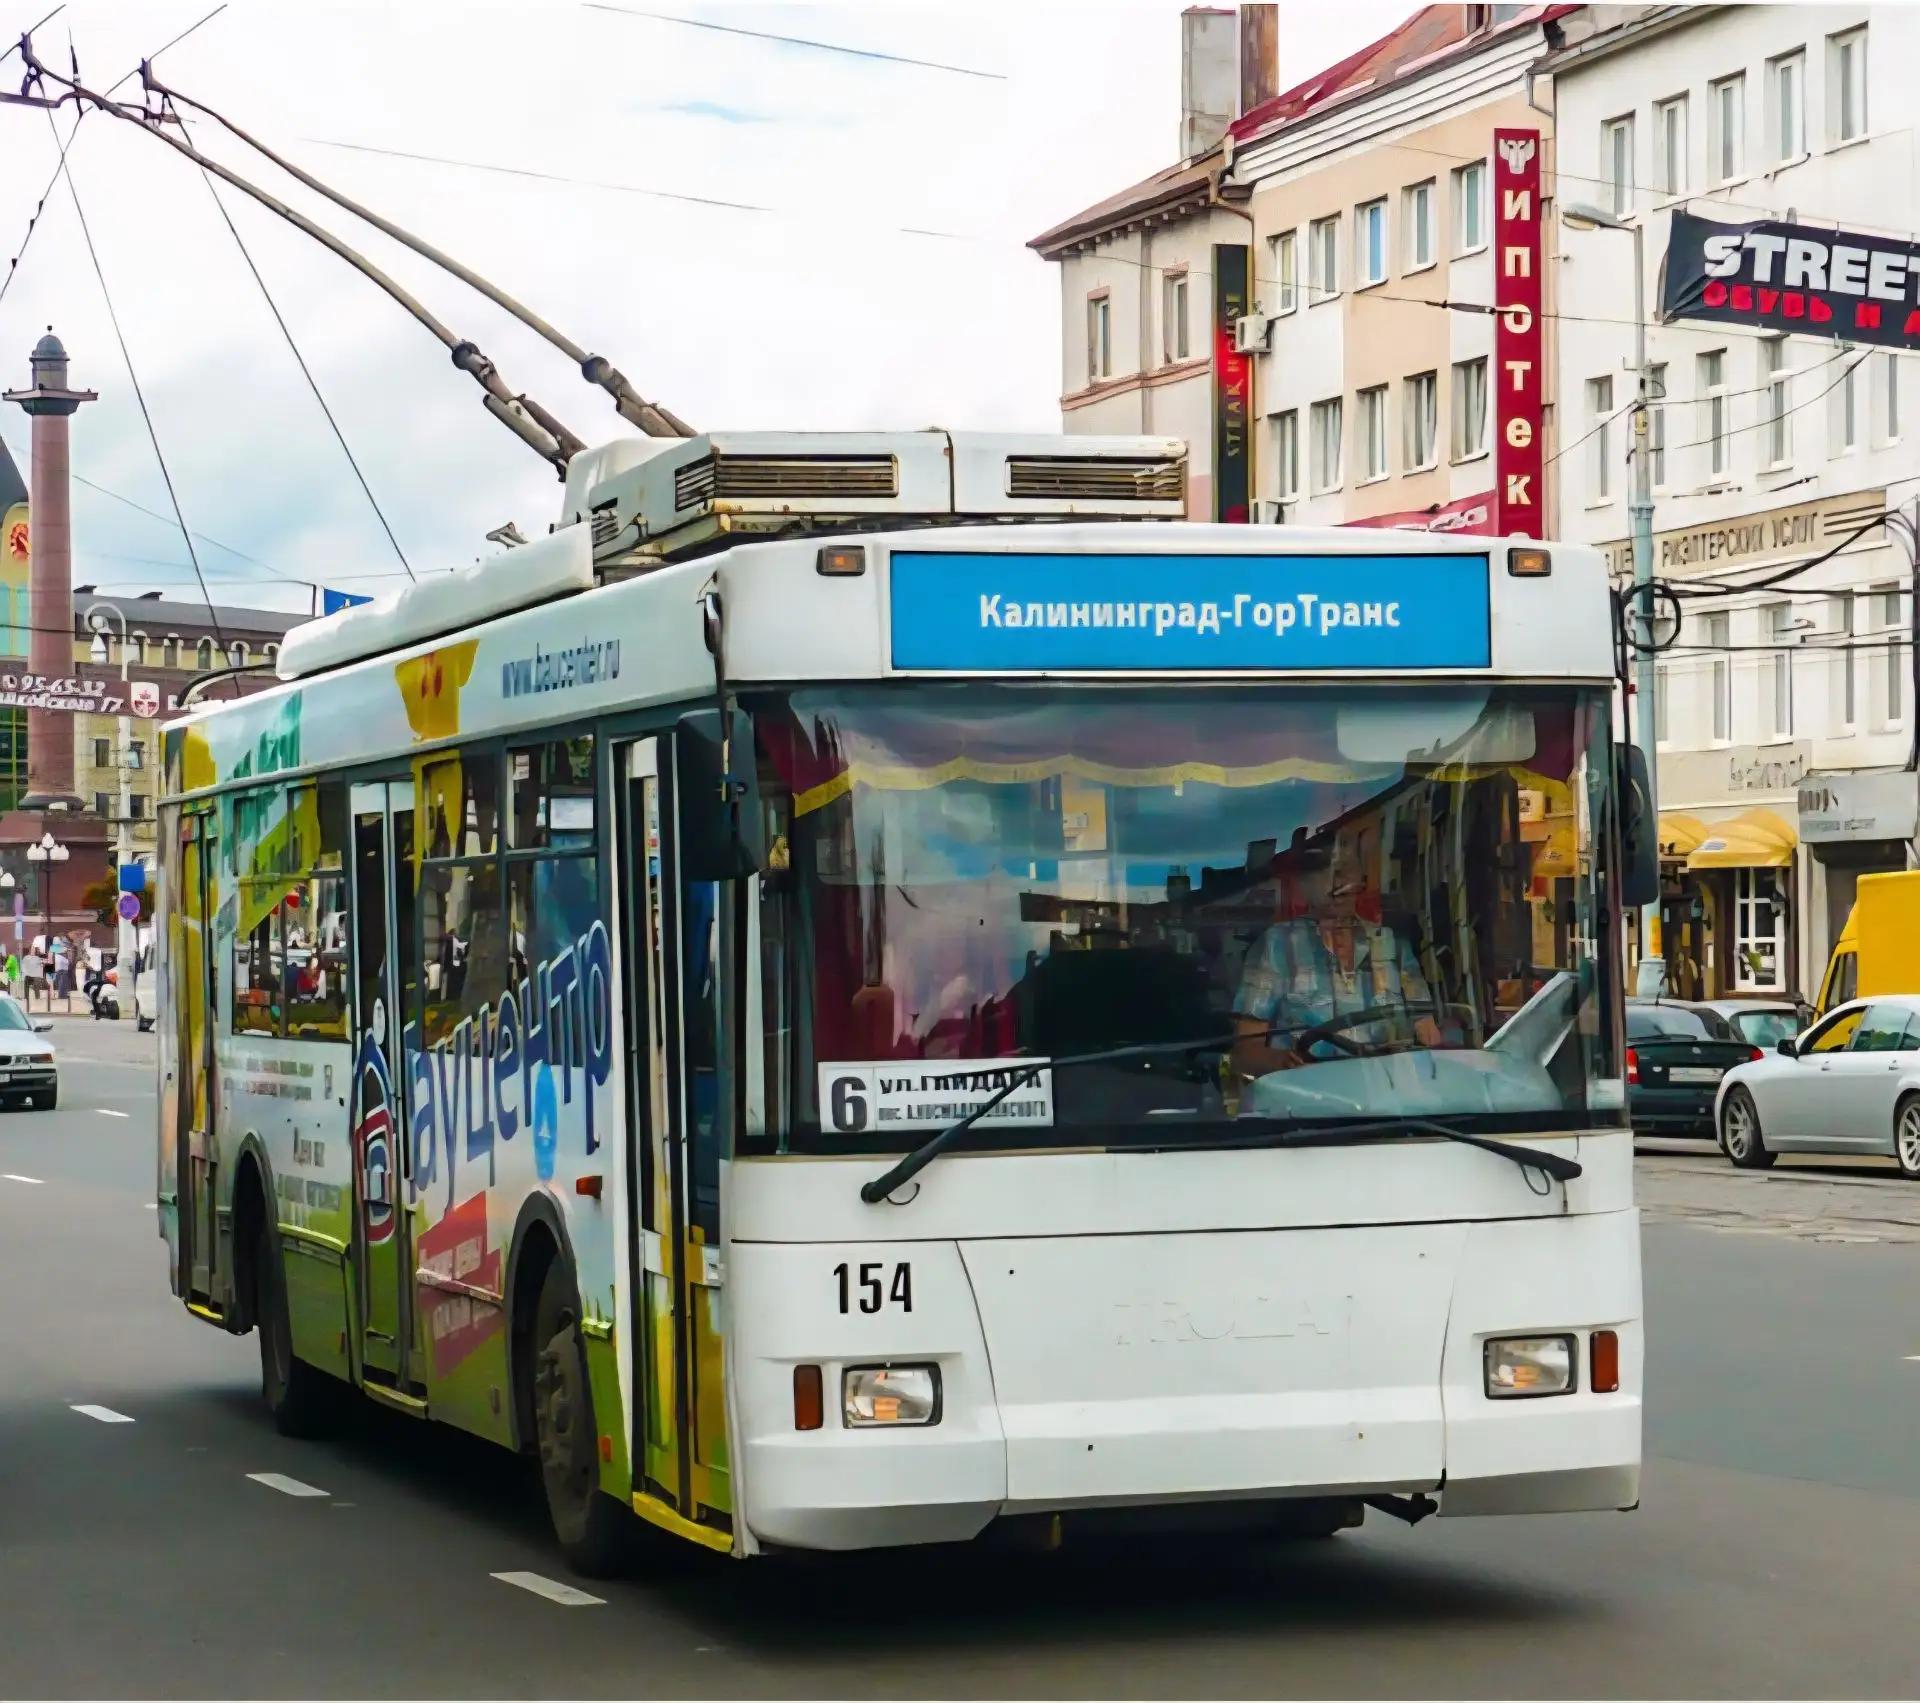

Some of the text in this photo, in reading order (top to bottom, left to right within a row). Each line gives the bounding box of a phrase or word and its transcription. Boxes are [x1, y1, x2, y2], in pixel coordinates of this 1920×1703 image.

[1702, 279, 1834, 322] ОБУВЬ
[1855, 302, 1882, 328] И
[1503, 189, 1532, 540] ипотек
[979, 593, 1401, 636] Калининград-ГорТранс
[831, 1076, 868, 1132] 6
[833, 1262, 912, 1314] 154
